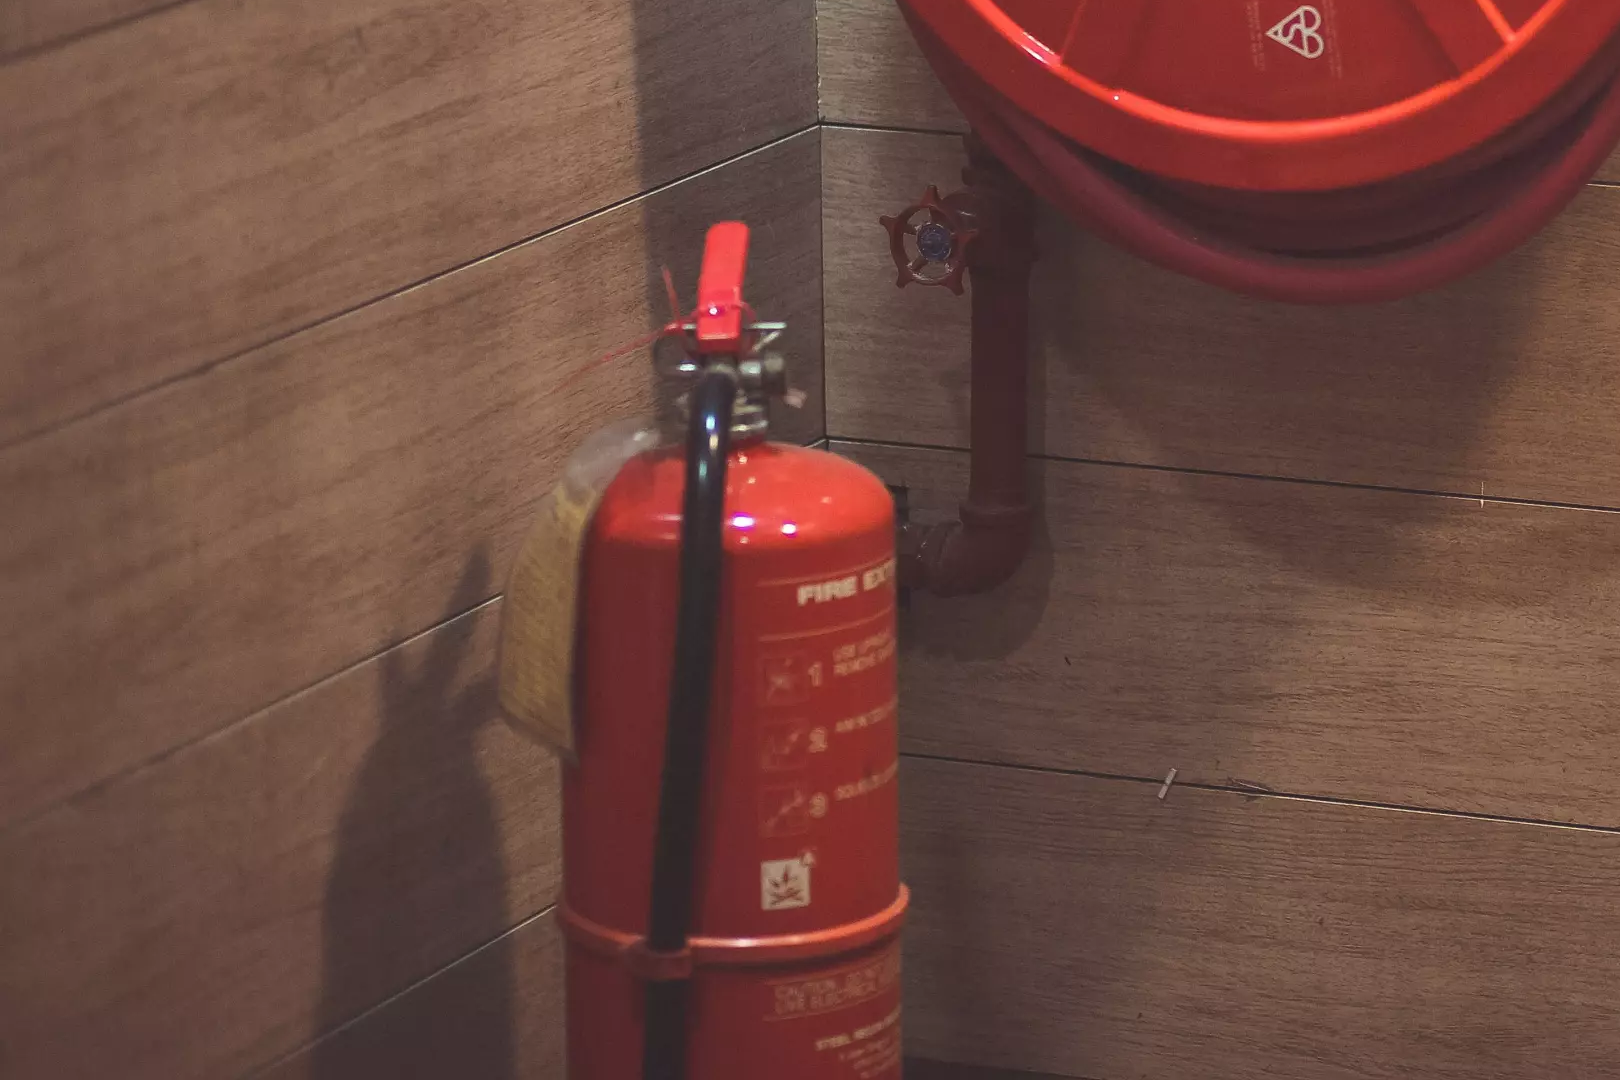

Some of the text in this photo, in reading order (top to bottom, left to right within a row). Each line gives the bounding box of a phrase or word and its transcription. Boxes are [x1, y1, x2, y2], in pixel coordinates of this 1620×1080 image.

[797, 576, 858, 606] FIRE
[808, 661, 823, 687] 1
[808, 726, 828, 754] 2
